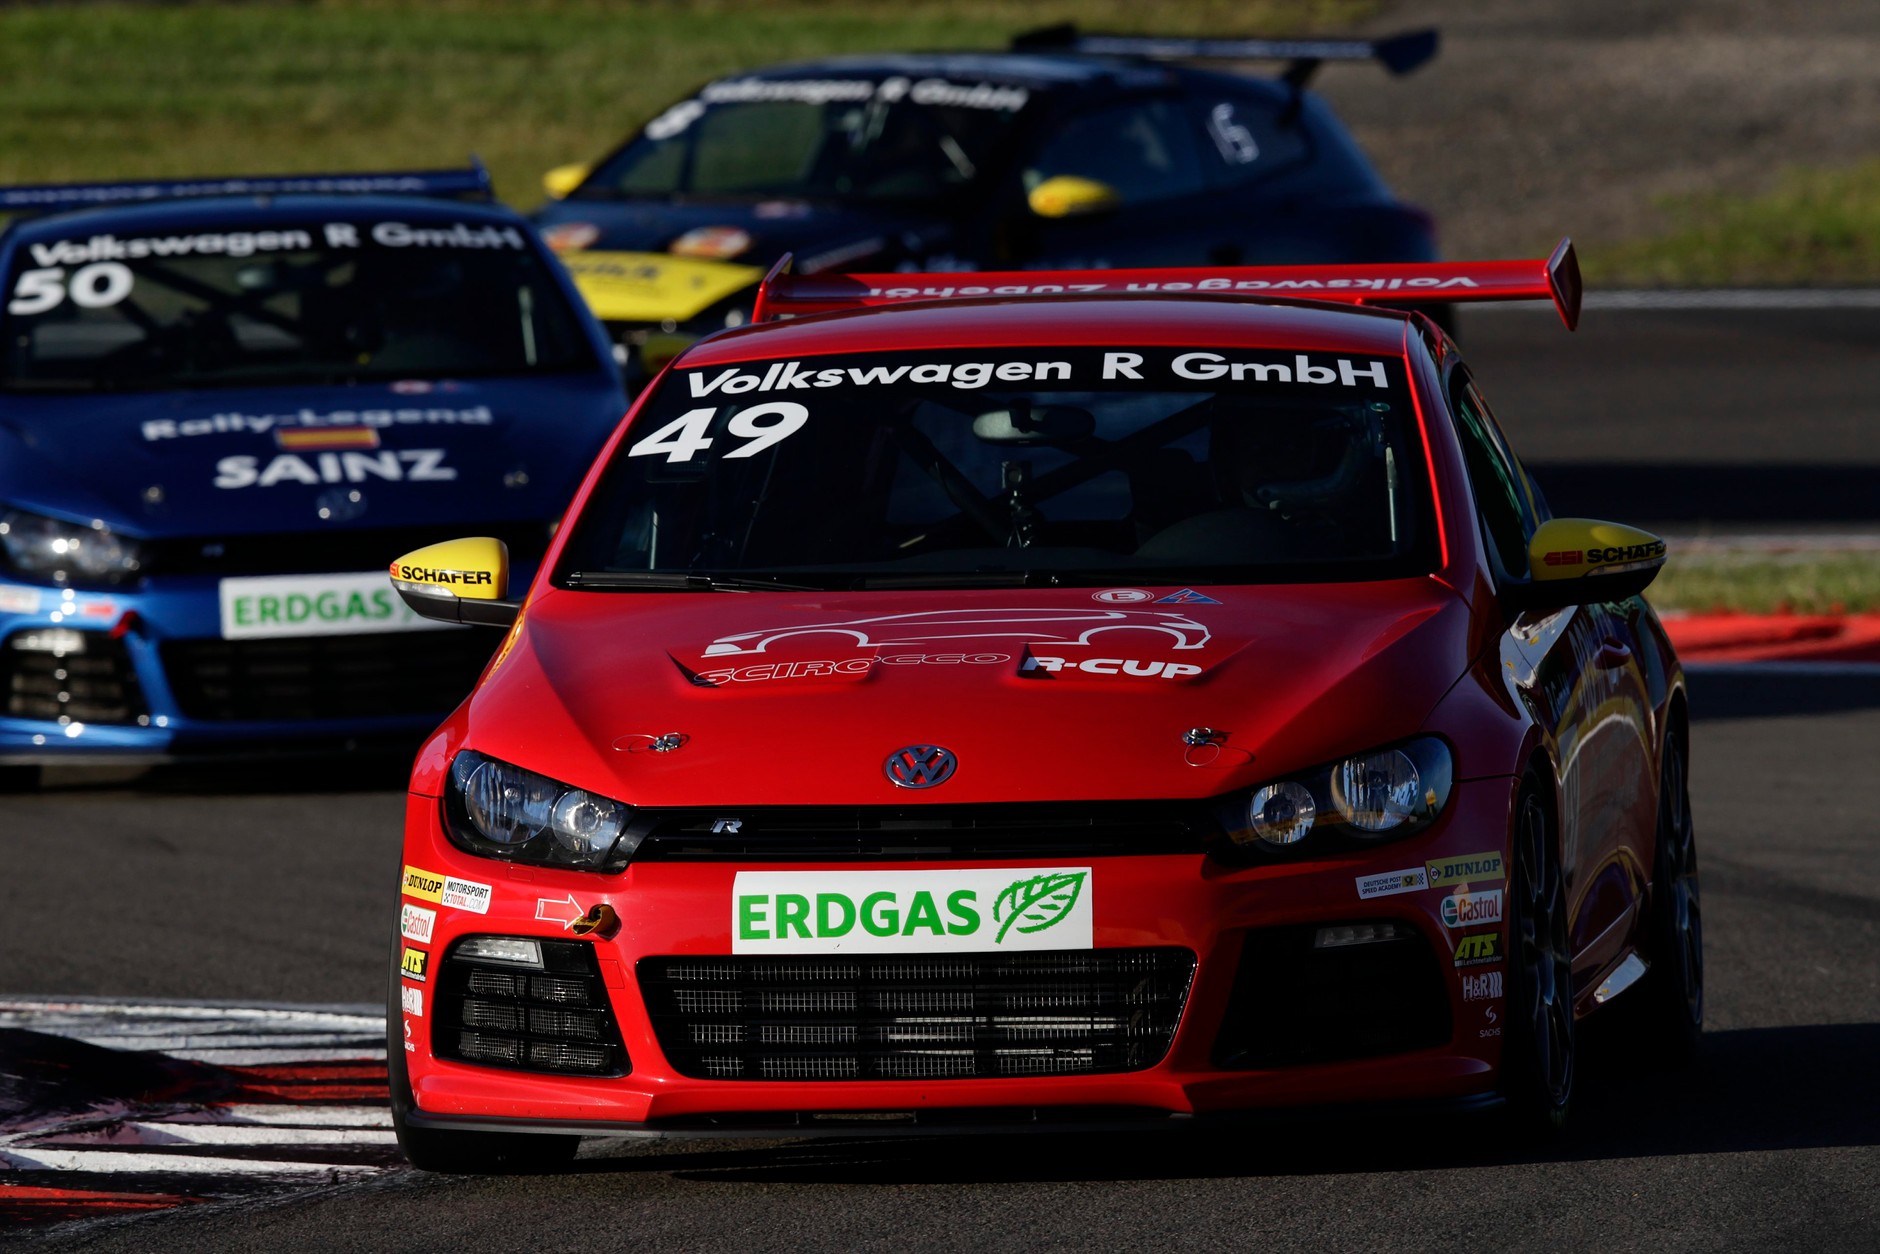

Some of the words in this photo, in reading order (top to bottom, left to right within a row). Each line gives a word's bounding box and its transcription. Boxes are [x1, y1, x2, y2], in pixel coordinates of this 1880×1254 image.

[29, 225, 313, 267] Volkswagen
[322, 222, 362, 249] R
[370, 221, 526, 250] GmbH
[7, 261, 134, 317] 50
[1126, 276, 1480, 292] Volkswagen
[688, 361, 1072, 398] Volkswagen
[1102, 352, 1145, 380] R
[1171, 352, 1389, 389] GmbH
[141, 405, 493, 442] Rally-Legend
[628, 401, 809, 464] 49
[212, 448, 458, 489] SAINZ
[1587, 541, 1666, 563] SCHÄFE
[401, 566, 492, 584] SCHÄFER
[235, 590, 393, 628] ERDGAS
[694, 653, 1011, 686] SCIROCCO
[1021, 656, 1202, 679] R-CUP
[710, 818, 743, 834] R
[1364, 878, 1389, 887] DEUTSCHE
[1390, 876, 1401, 884] POST
[1444, 859, 1500, 878] DUNLOP
[408, 874, 442, 893] DUNLOP
[447, 881, 489, 899] MOTORSPORT
[1362, 887, 1377, 895] SPEED
[1378, 883, 1401, 892] ACADEMY
[738, 890, 981, 940] ERDGAS
[1459, 895, 1500, 922] Castrol
[407, 910, 430, 937] Castrol
[1454, 933, 1498, 960] ATS
[401, 948, 425, 974] ATS
[1462, 973, 1489, 1001] H&R
[1480, 1027, 1501, 1038] SACHS
